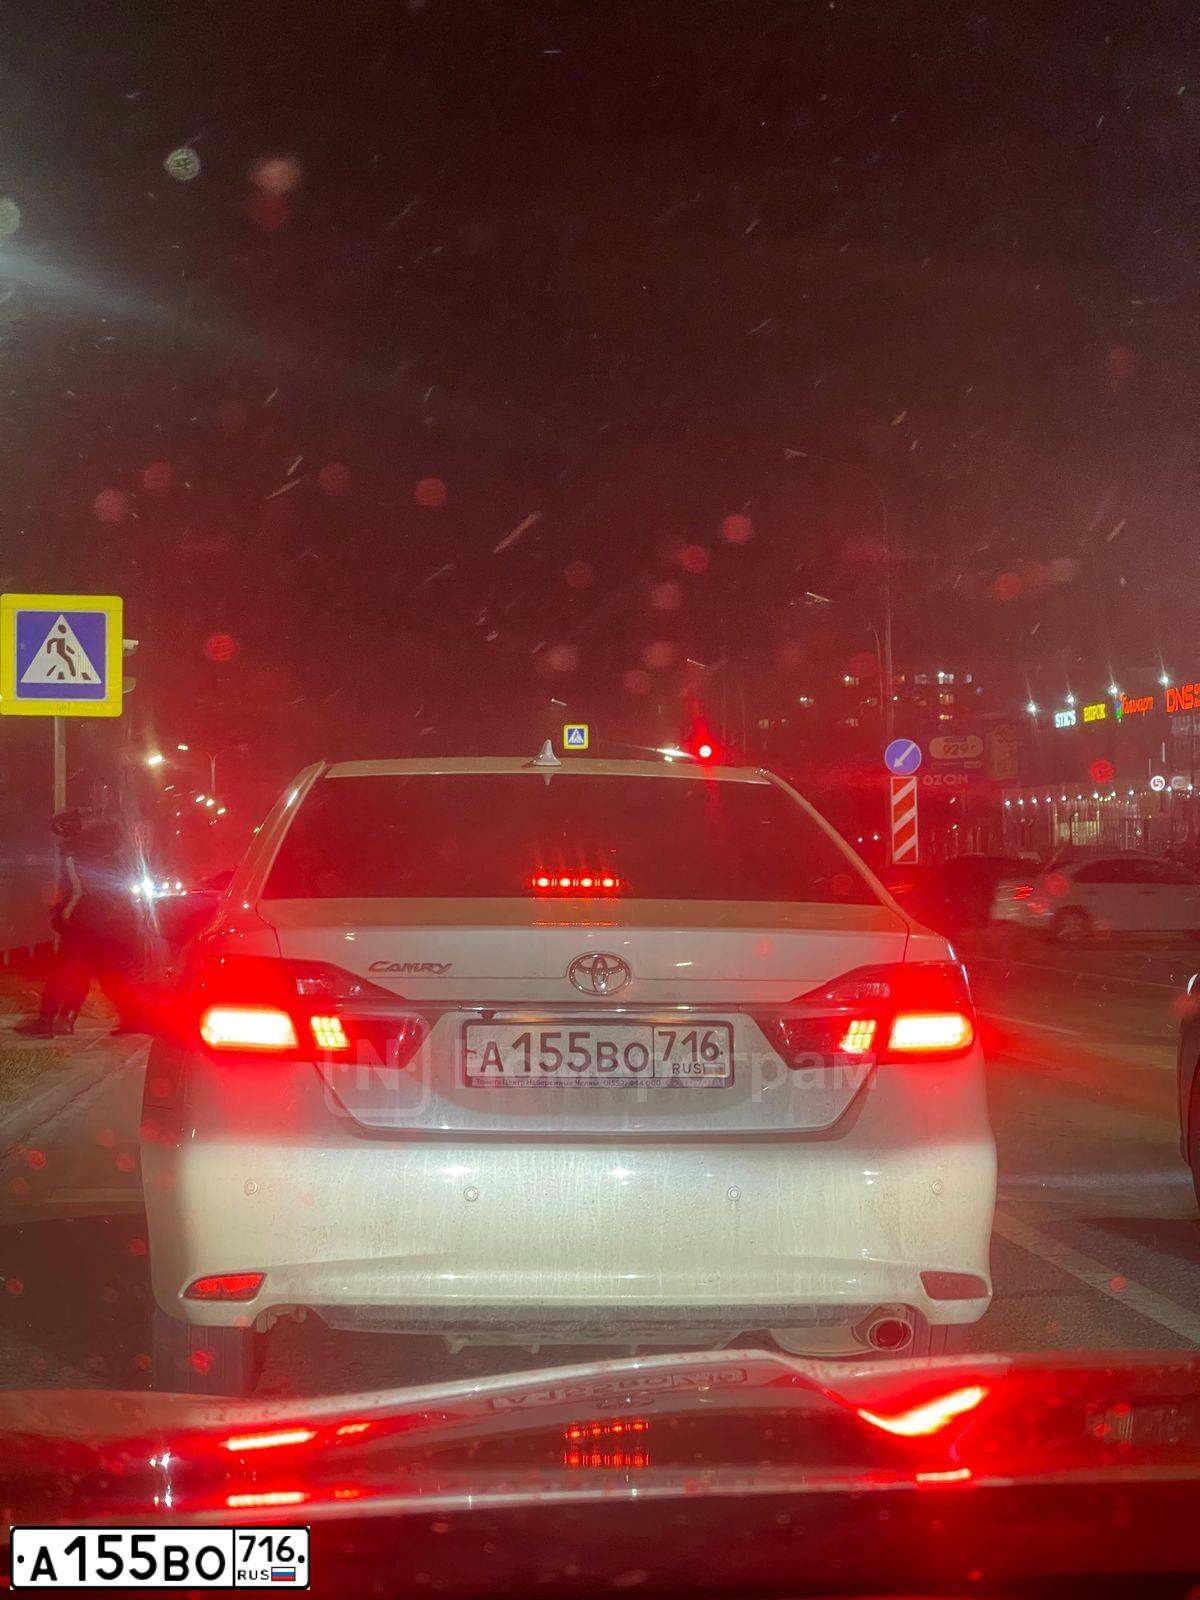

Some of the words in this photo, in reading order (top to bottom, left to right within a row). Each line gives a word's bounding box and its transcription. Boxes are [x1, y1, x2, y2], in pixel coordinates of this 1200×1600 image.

[923, 774, 968, 786] OZON
[658, 1030, 720, 1062] 716
[672, 1062, 702, 1074] RUS
